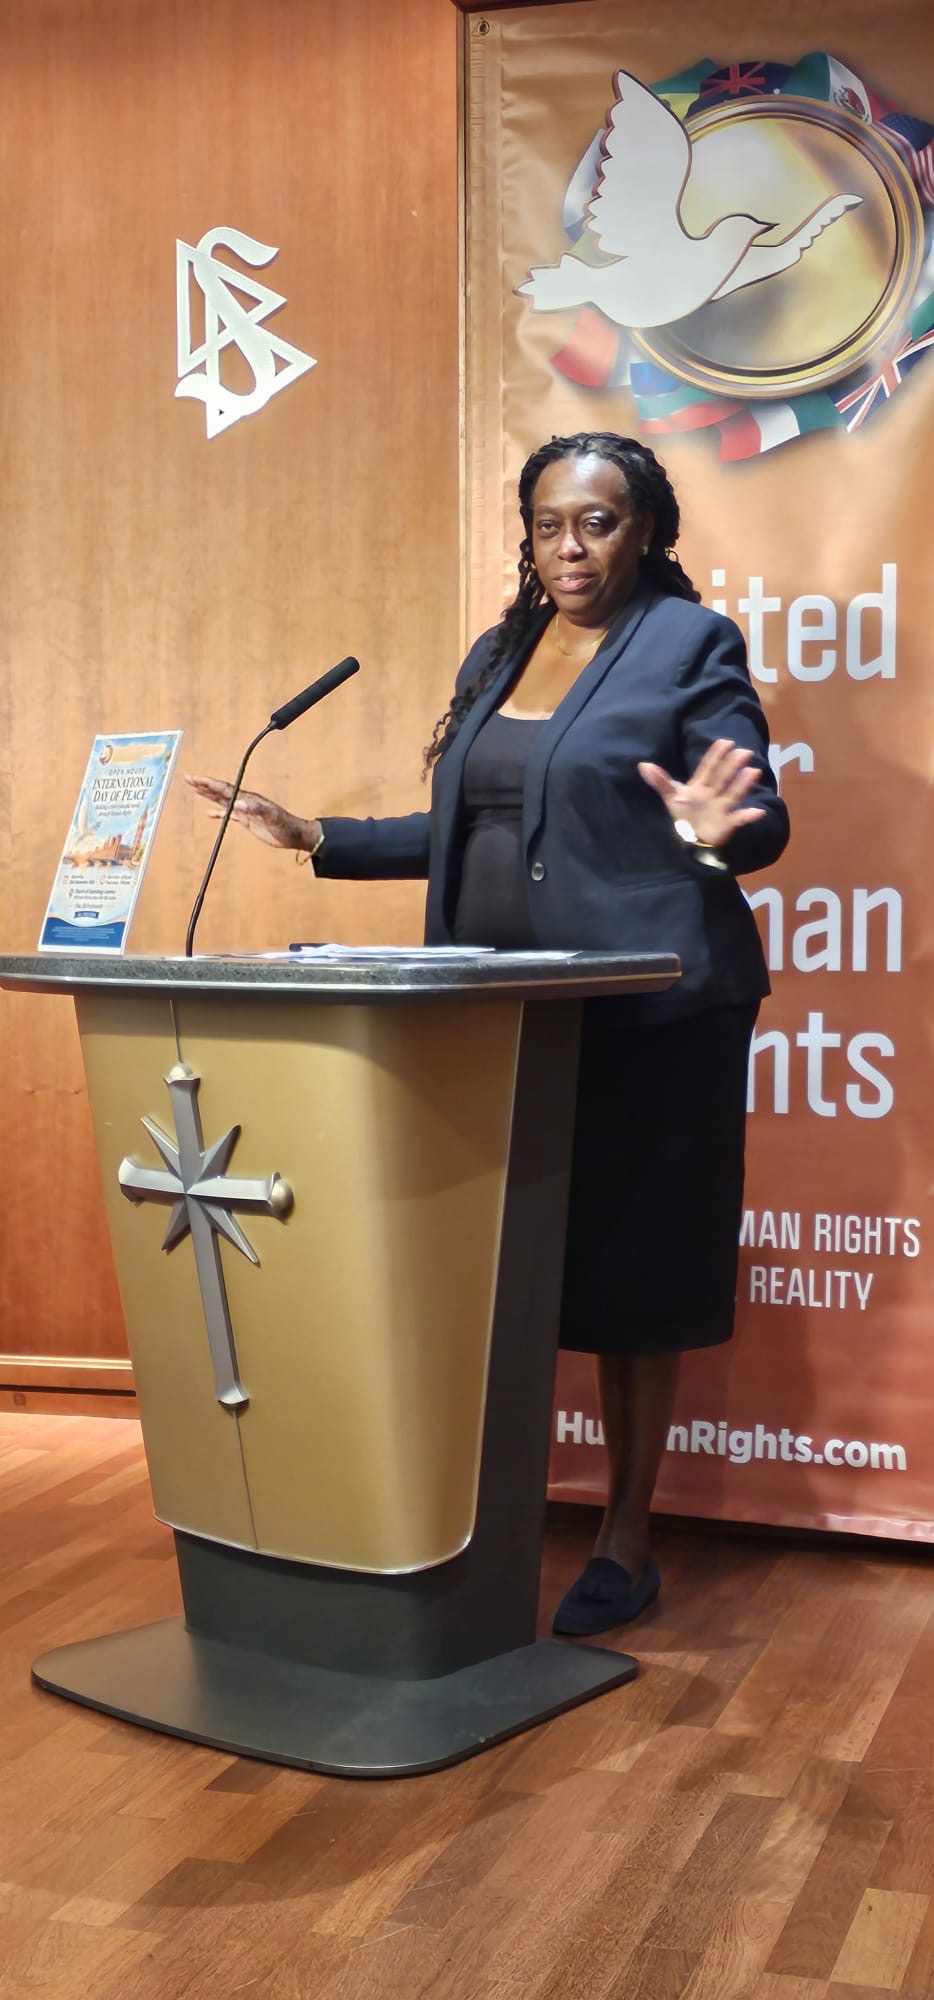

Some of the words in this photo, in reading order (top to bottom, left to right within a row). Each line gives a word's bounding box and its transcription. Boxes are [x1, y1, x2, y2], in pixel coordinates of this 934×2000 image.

[92, 775, 155, 790] INTERNATIONAL
[93, 790, 108, 802] DAY
[109, 790, 122, 801] OF
[121, 788, 149, 801] PEACE
[814, 1213, 921, 1258] RIGHTS
[750, 1266, 874, 1311] REALITY
[556, 1410, 908, 1471] HunRights.com
